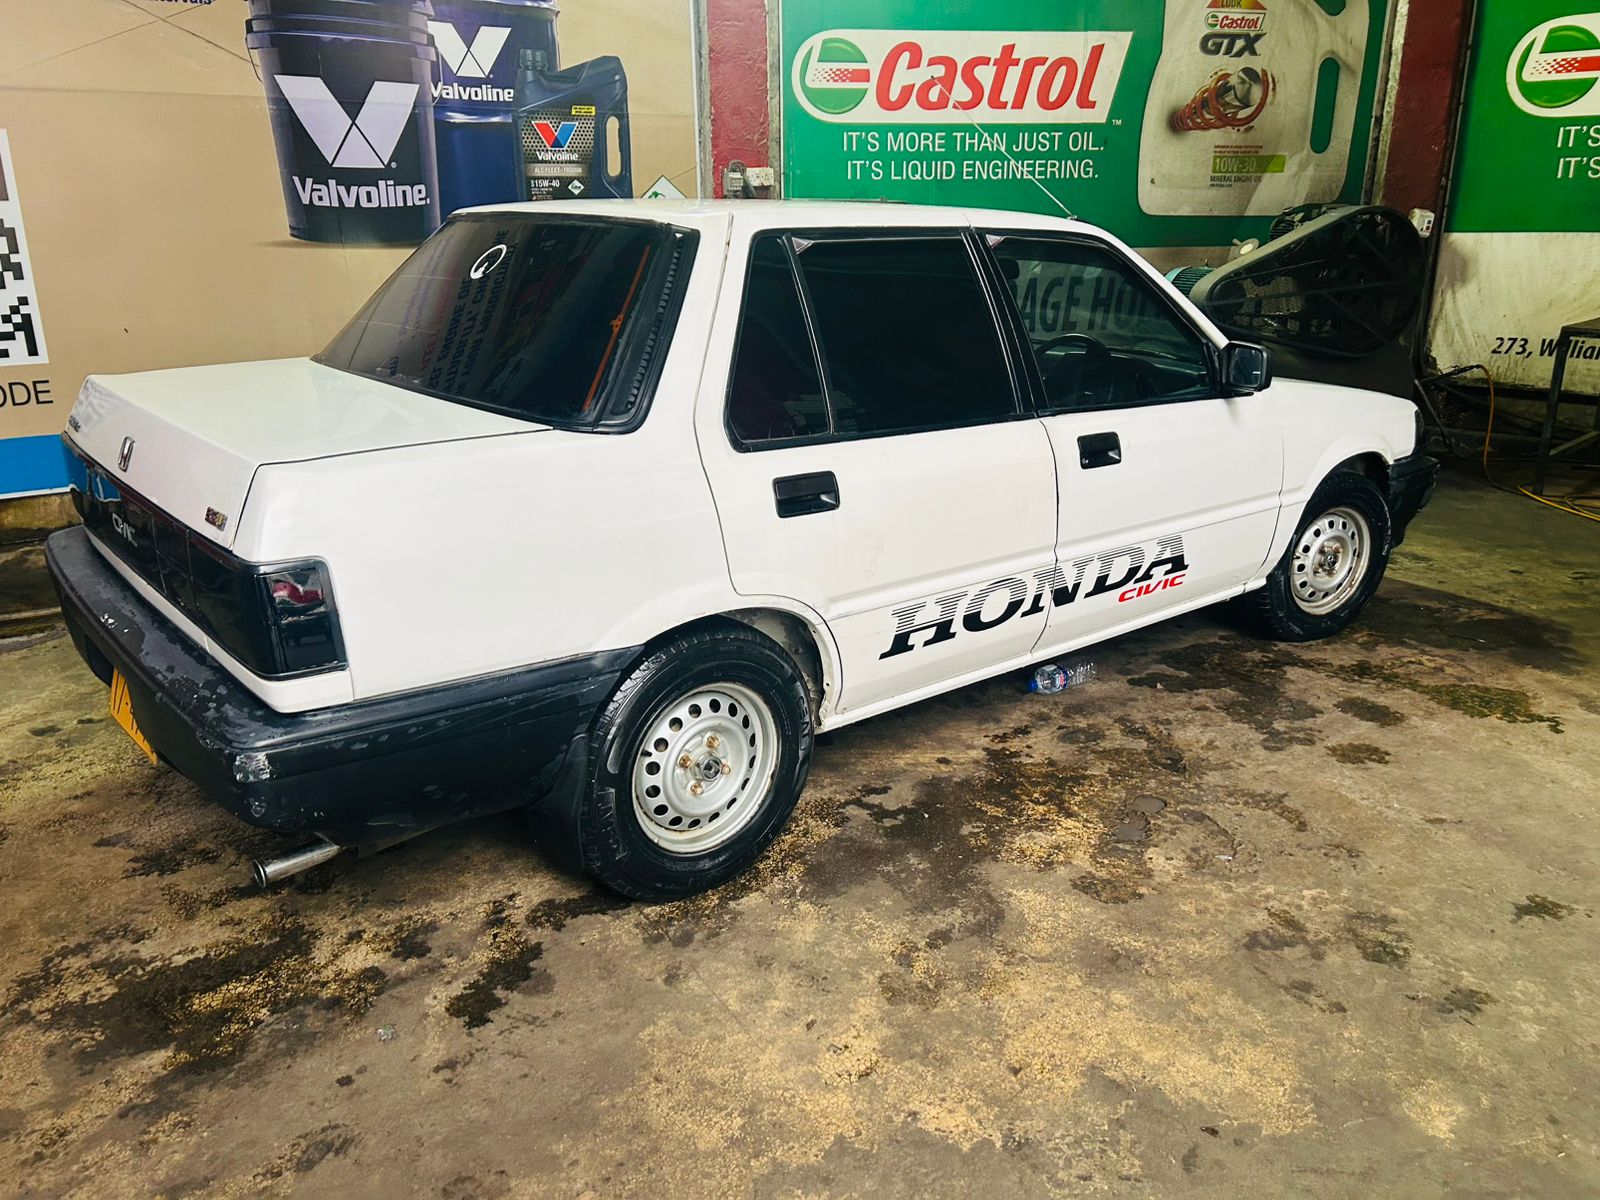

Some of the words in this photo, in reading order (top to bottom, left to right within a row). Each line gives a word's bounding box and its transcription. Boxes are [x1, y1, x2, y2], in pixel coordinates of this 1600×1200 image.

[1219, 15, 1260, 29] Castrol
[1199, 32, 1267, 58] GTX
[875, 41, 1105, 112] Castrol
[430, 81, 514, 102] Valvoline
[842, 131, 880, 153] IT'S
[887, 132, 946, 153] MORE
[952, 131, 1007, 152] THAN
[1013, 131, 1063, 152] JUST
[1069, 131, 1105, 152] OIL.
[1557, 125, 1600, 148] IT'S
[535, 151, 579, 161] Valvoline
[1557, 156, 1600, 179] IT'S
[846, 160, 884, 181] IT'S
[890, 160, 956, 181] LIQUID
[962, 159, 1099, 181] ENGINEERING.
[1490, 337, 1534, 359] 273,
[0, 379, 54, 408] DE
[878, 533, 1190, 660] HONDA
[1118, 573, 1187, 603] CIVIC
